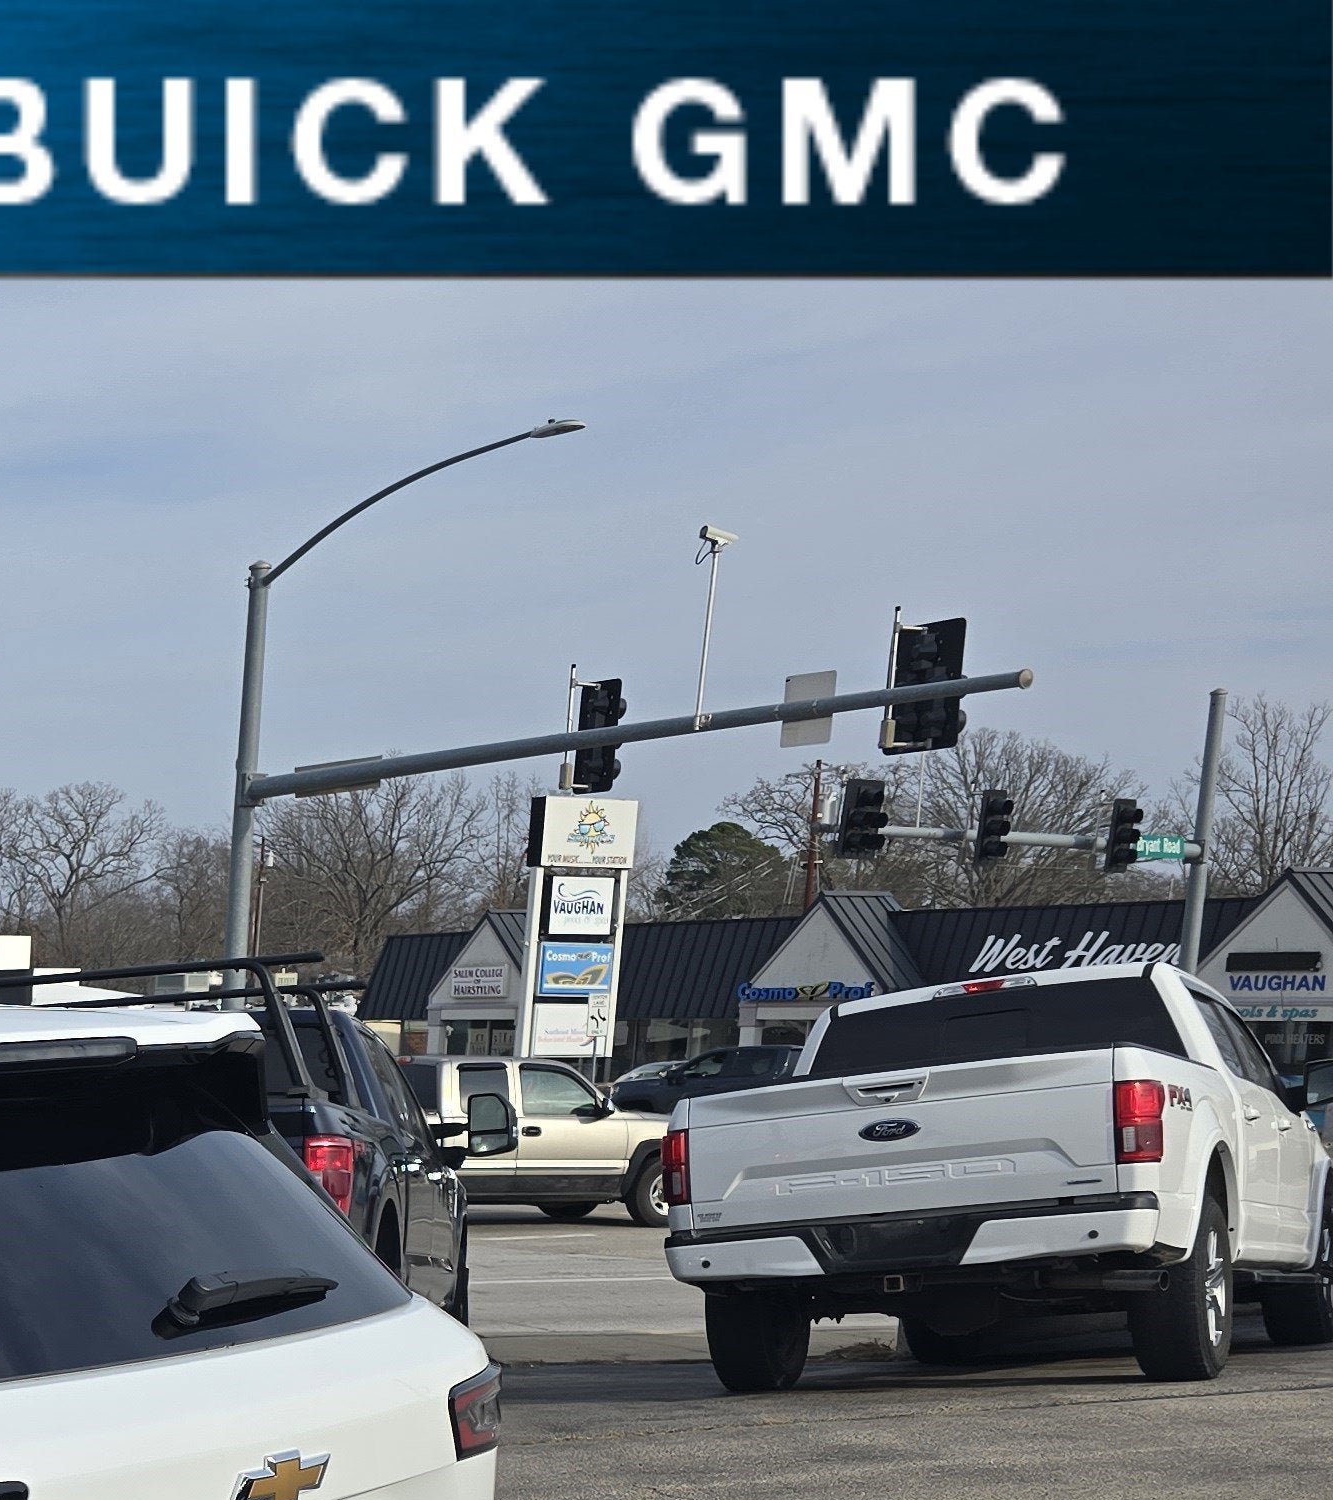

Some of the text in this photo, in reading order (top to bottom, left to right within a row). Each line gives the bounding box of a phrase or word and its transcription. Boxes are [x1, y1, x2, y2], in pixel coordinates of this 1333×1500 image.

[553, 900, 604, 915] VAUGHAN
[546, 950, 611, 962] Cosmo Prof
[969, 930, 1182, 973] West Haven
[453, 968, 503, 978] SALEM COLLEGE
[453, 984, 501, 995] HAIRSTYLING
[1229, 975, 1326, 991] VAUGHAN
[737, 981, 875, 1001] Cosmo Prof
[1281, 1007, 1318, 1021] spas
[1168, 1084, 1192, 1107] FX4
[873, 1123, 906, 1137] Ford
[776, 1157, 1016, 1196] F-150
